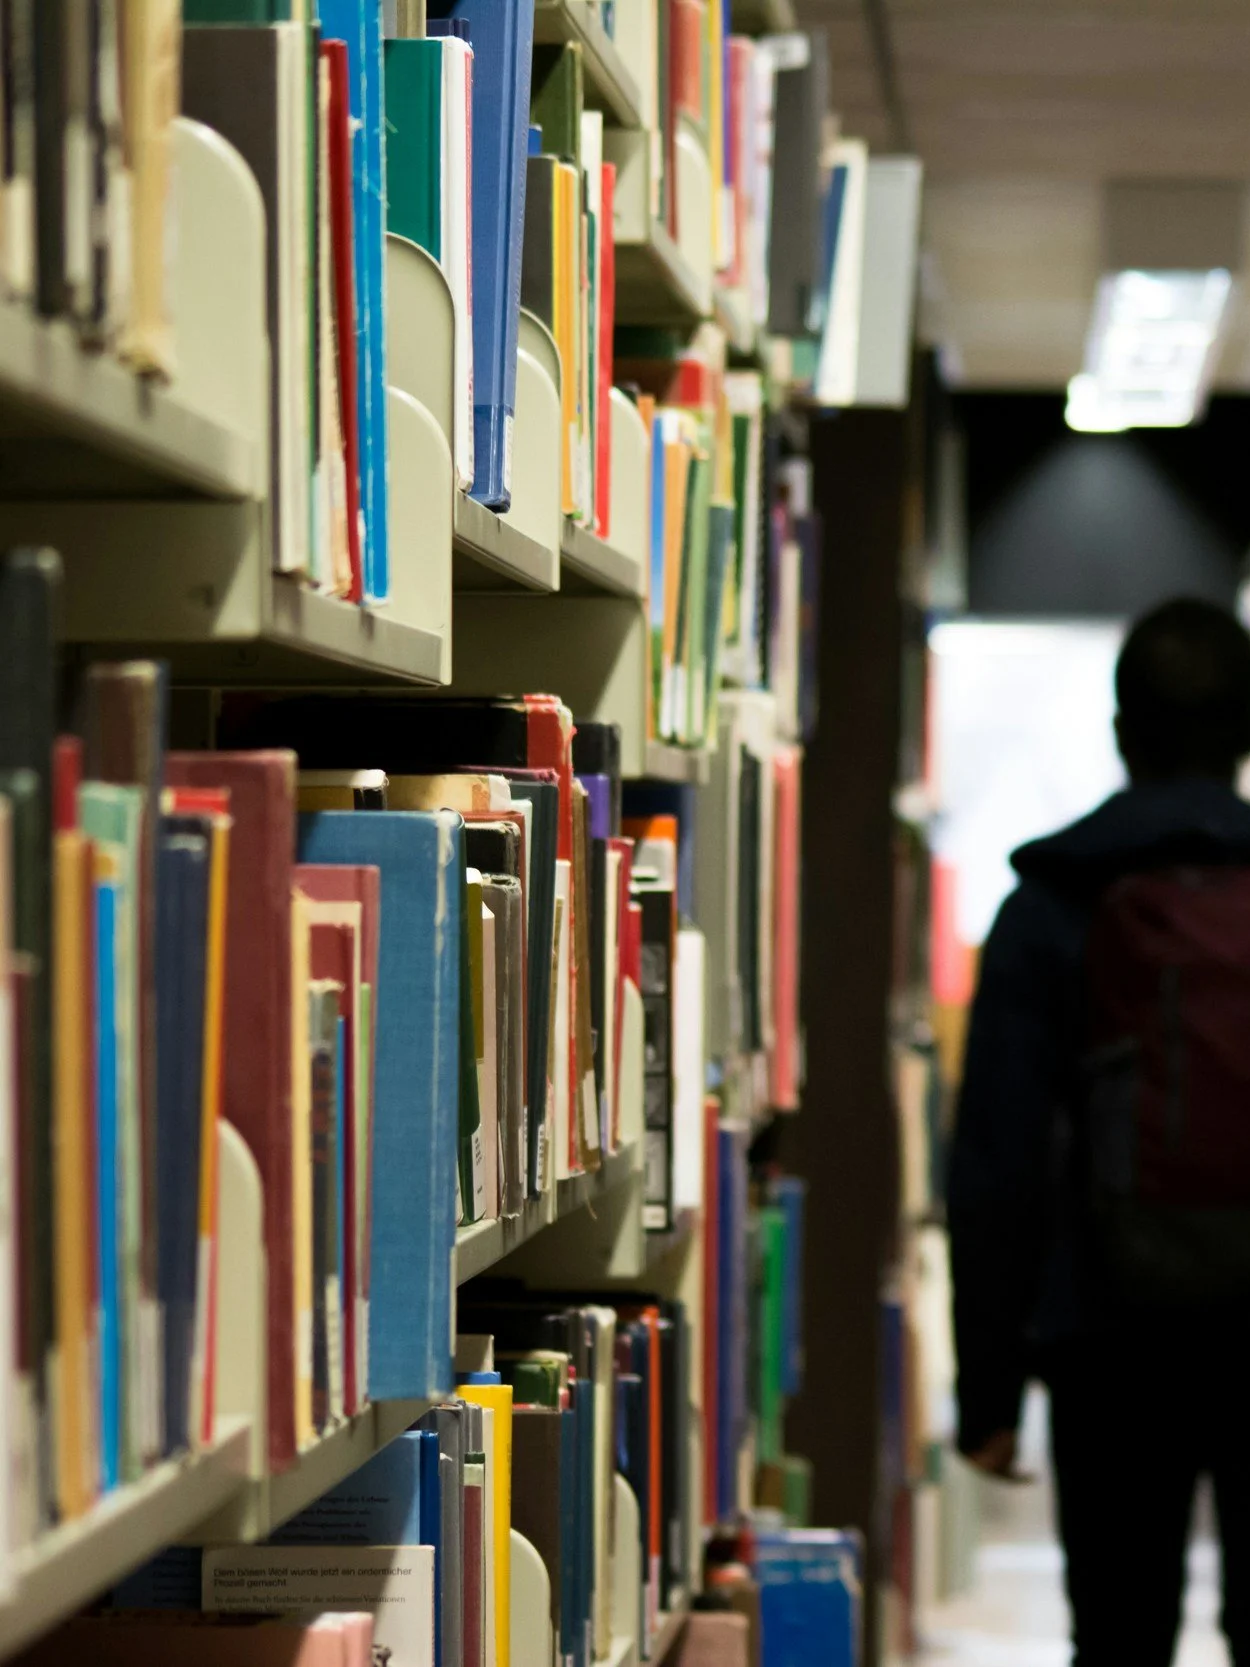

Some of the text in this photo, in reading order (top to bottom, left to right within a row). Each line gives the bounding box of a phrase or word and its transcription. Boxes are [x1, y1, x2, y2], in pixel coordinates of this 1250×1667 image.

[268, 1568, 288, 1577] Wolf
[290, 1568, 318, 1577] wurde
[320, 1568, 339, 1578] jetzt
[341, 1568, 356, 1576] ein
[358, 1567, 412, 1576] ordentlicher
[246, 1579, 287, 1589] gemacht
[364, 1595, 406, 1603] Variationen
